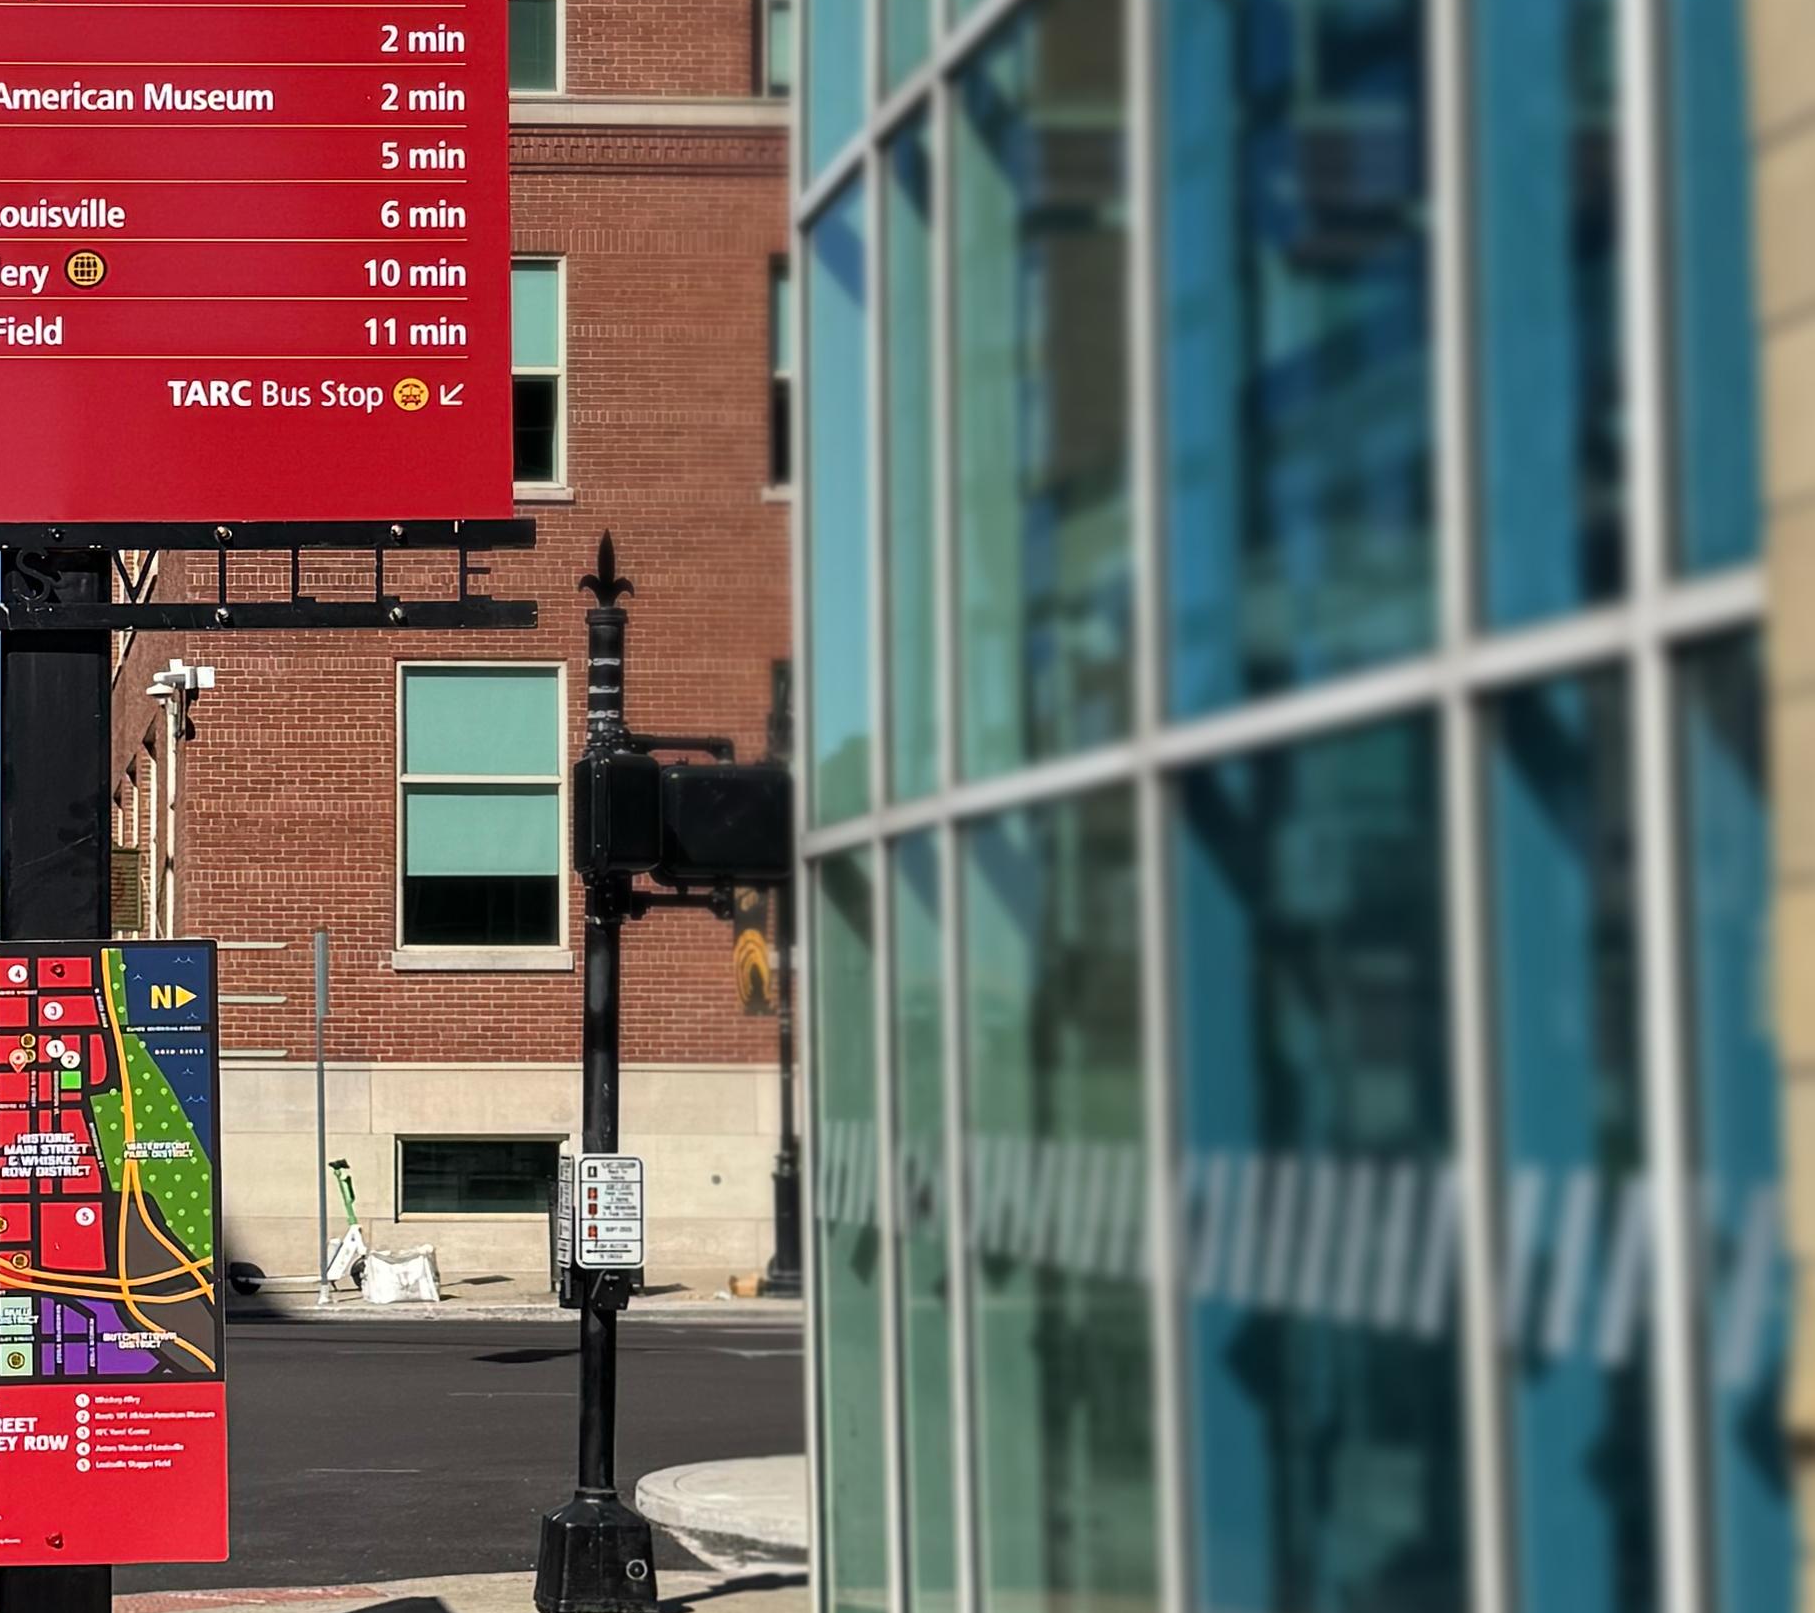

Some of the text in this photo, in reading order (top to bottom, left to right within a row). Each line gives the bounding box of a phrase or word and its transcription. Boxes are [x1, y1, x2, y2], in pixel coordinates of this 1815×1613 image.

[380, 23, 465, 53] 2 min
[144, 82, 274, 111] Museum
[381, 81, 465, 111] 2 min
[381, 140, 466, 170] 5 min
[380, 199, 466, 229] 6 min
[363, 257, 467, 287] 10 min
[363, 316, 467, 346] 11 min
[167, 379, 384, 413] TARC Bus Stop
[151, 985, 172, 1010] N
[17, 1132, 75, 1144] HISTORIC
[40, 1143, 89, 1154] STREET
[1, 1166, 91, 1177] ROW DISTRICT
[20, 1155, 80, 1166] WHISKEY
[23, 1435, 69, 1451] ROW
